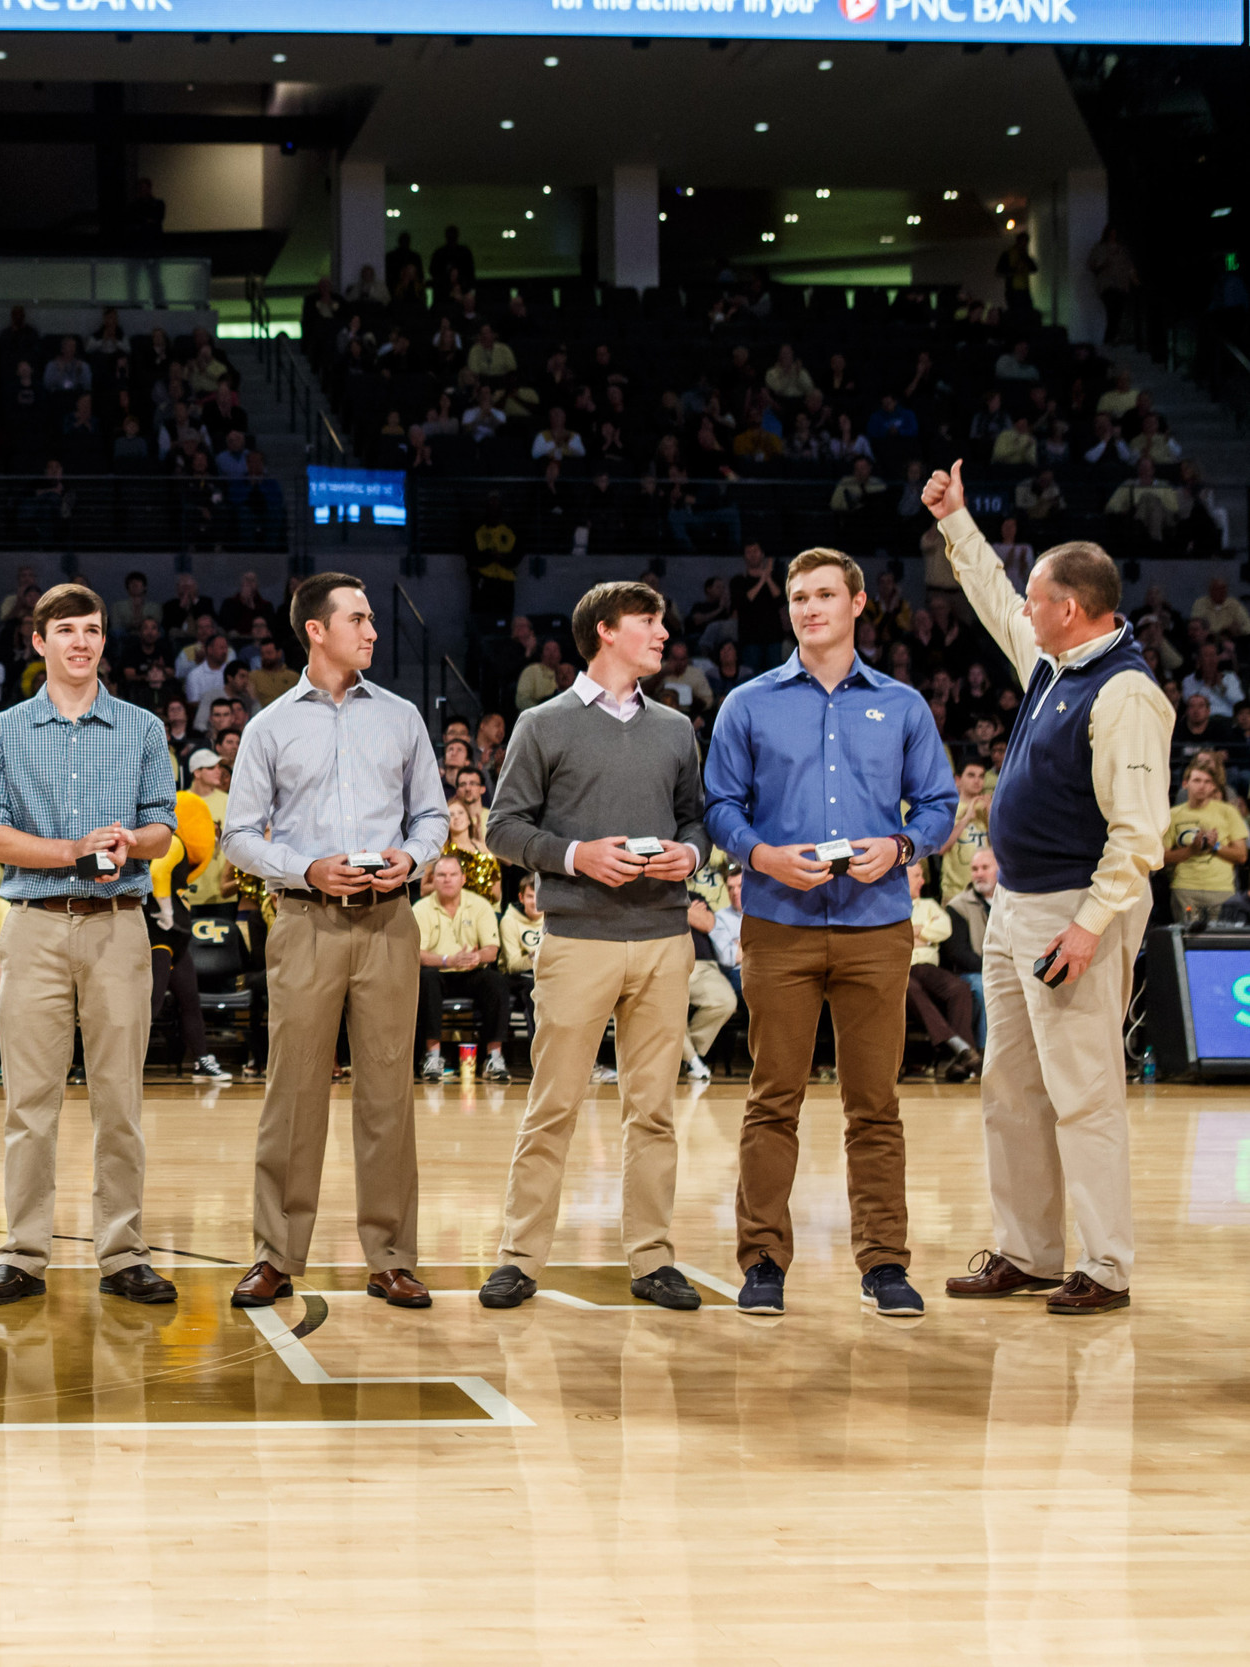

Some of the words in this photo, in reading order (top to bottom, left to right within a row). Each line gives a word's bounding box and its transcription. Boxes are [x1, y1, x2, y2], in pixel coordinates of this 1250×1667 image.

[885, 0, 968, 23] PNC
[972, 0, 1077, 24] BANK
[975, 496, 1002, 512] 110
[192, 920, 230, 943] GT
